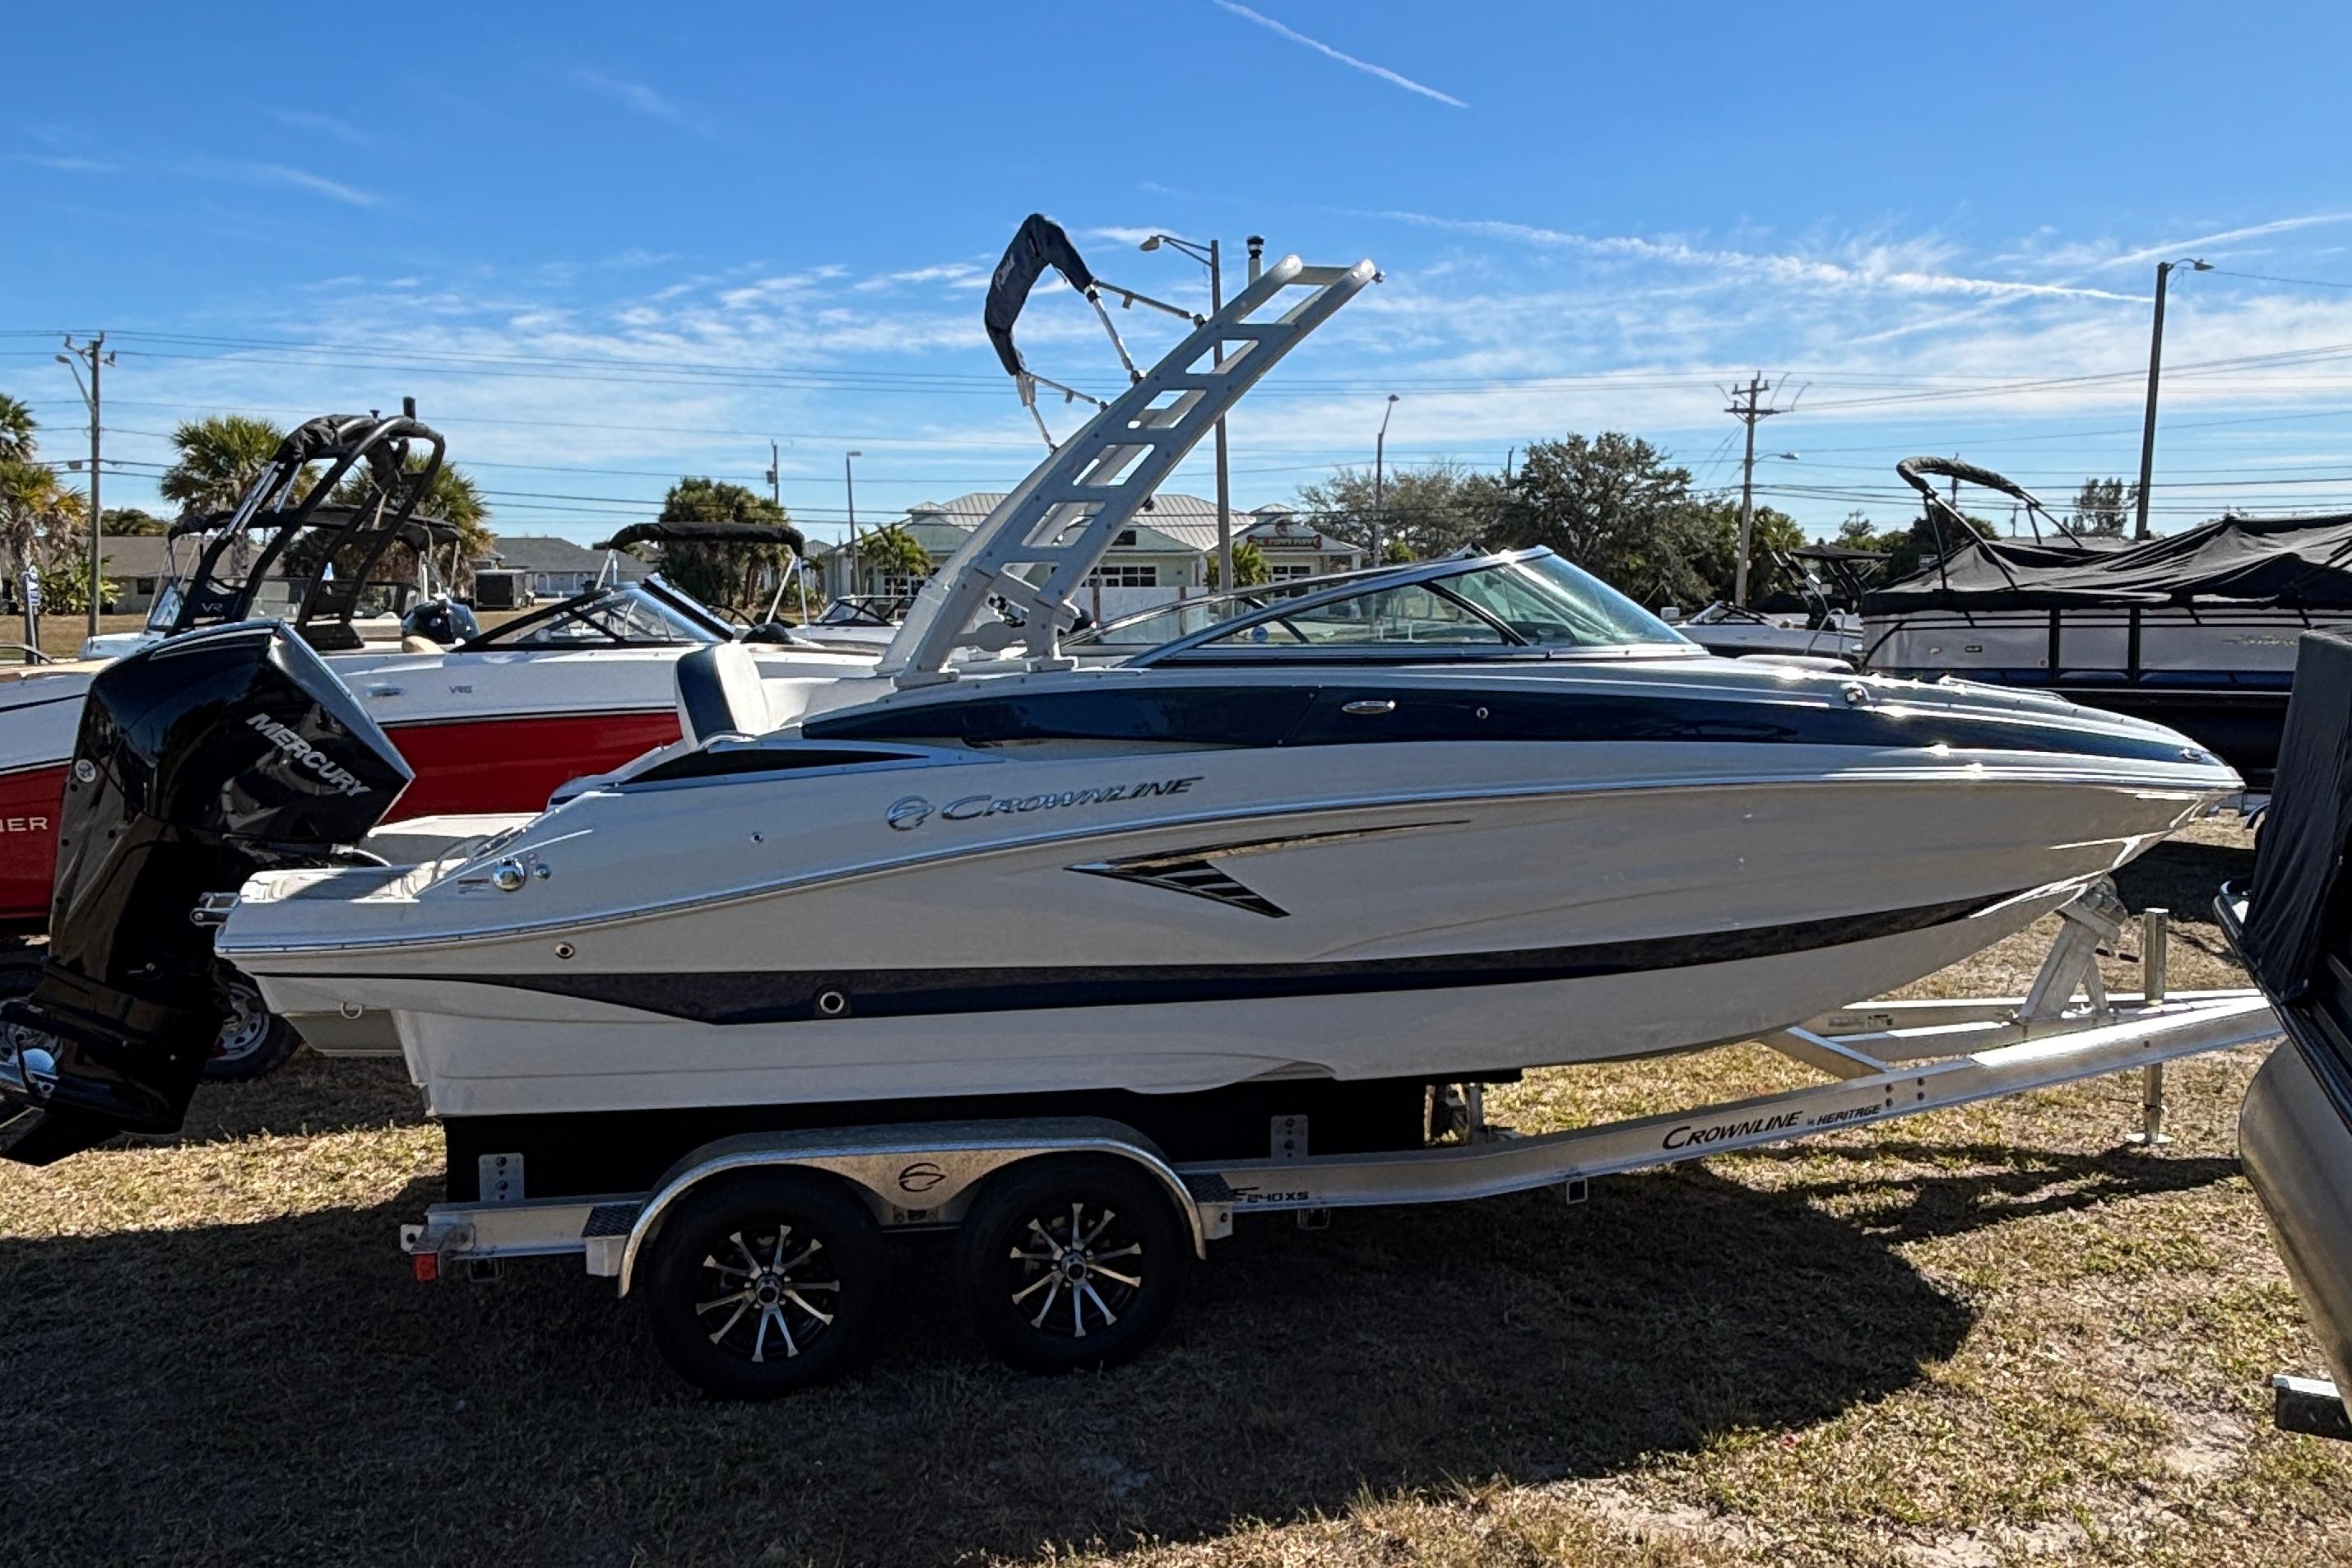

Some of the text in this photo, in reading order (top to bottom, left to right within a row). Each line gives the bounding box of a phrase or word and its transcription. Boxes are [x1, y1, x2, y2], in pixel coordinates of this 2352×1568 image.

[246, 712, 372, 796] MERCURY
[941, 776, 1204, 820] CROWNLINE
[0, 817, 48, 832] ER
[1662, 1103, 1882, 1150] CROWNLINE HERITAGE
